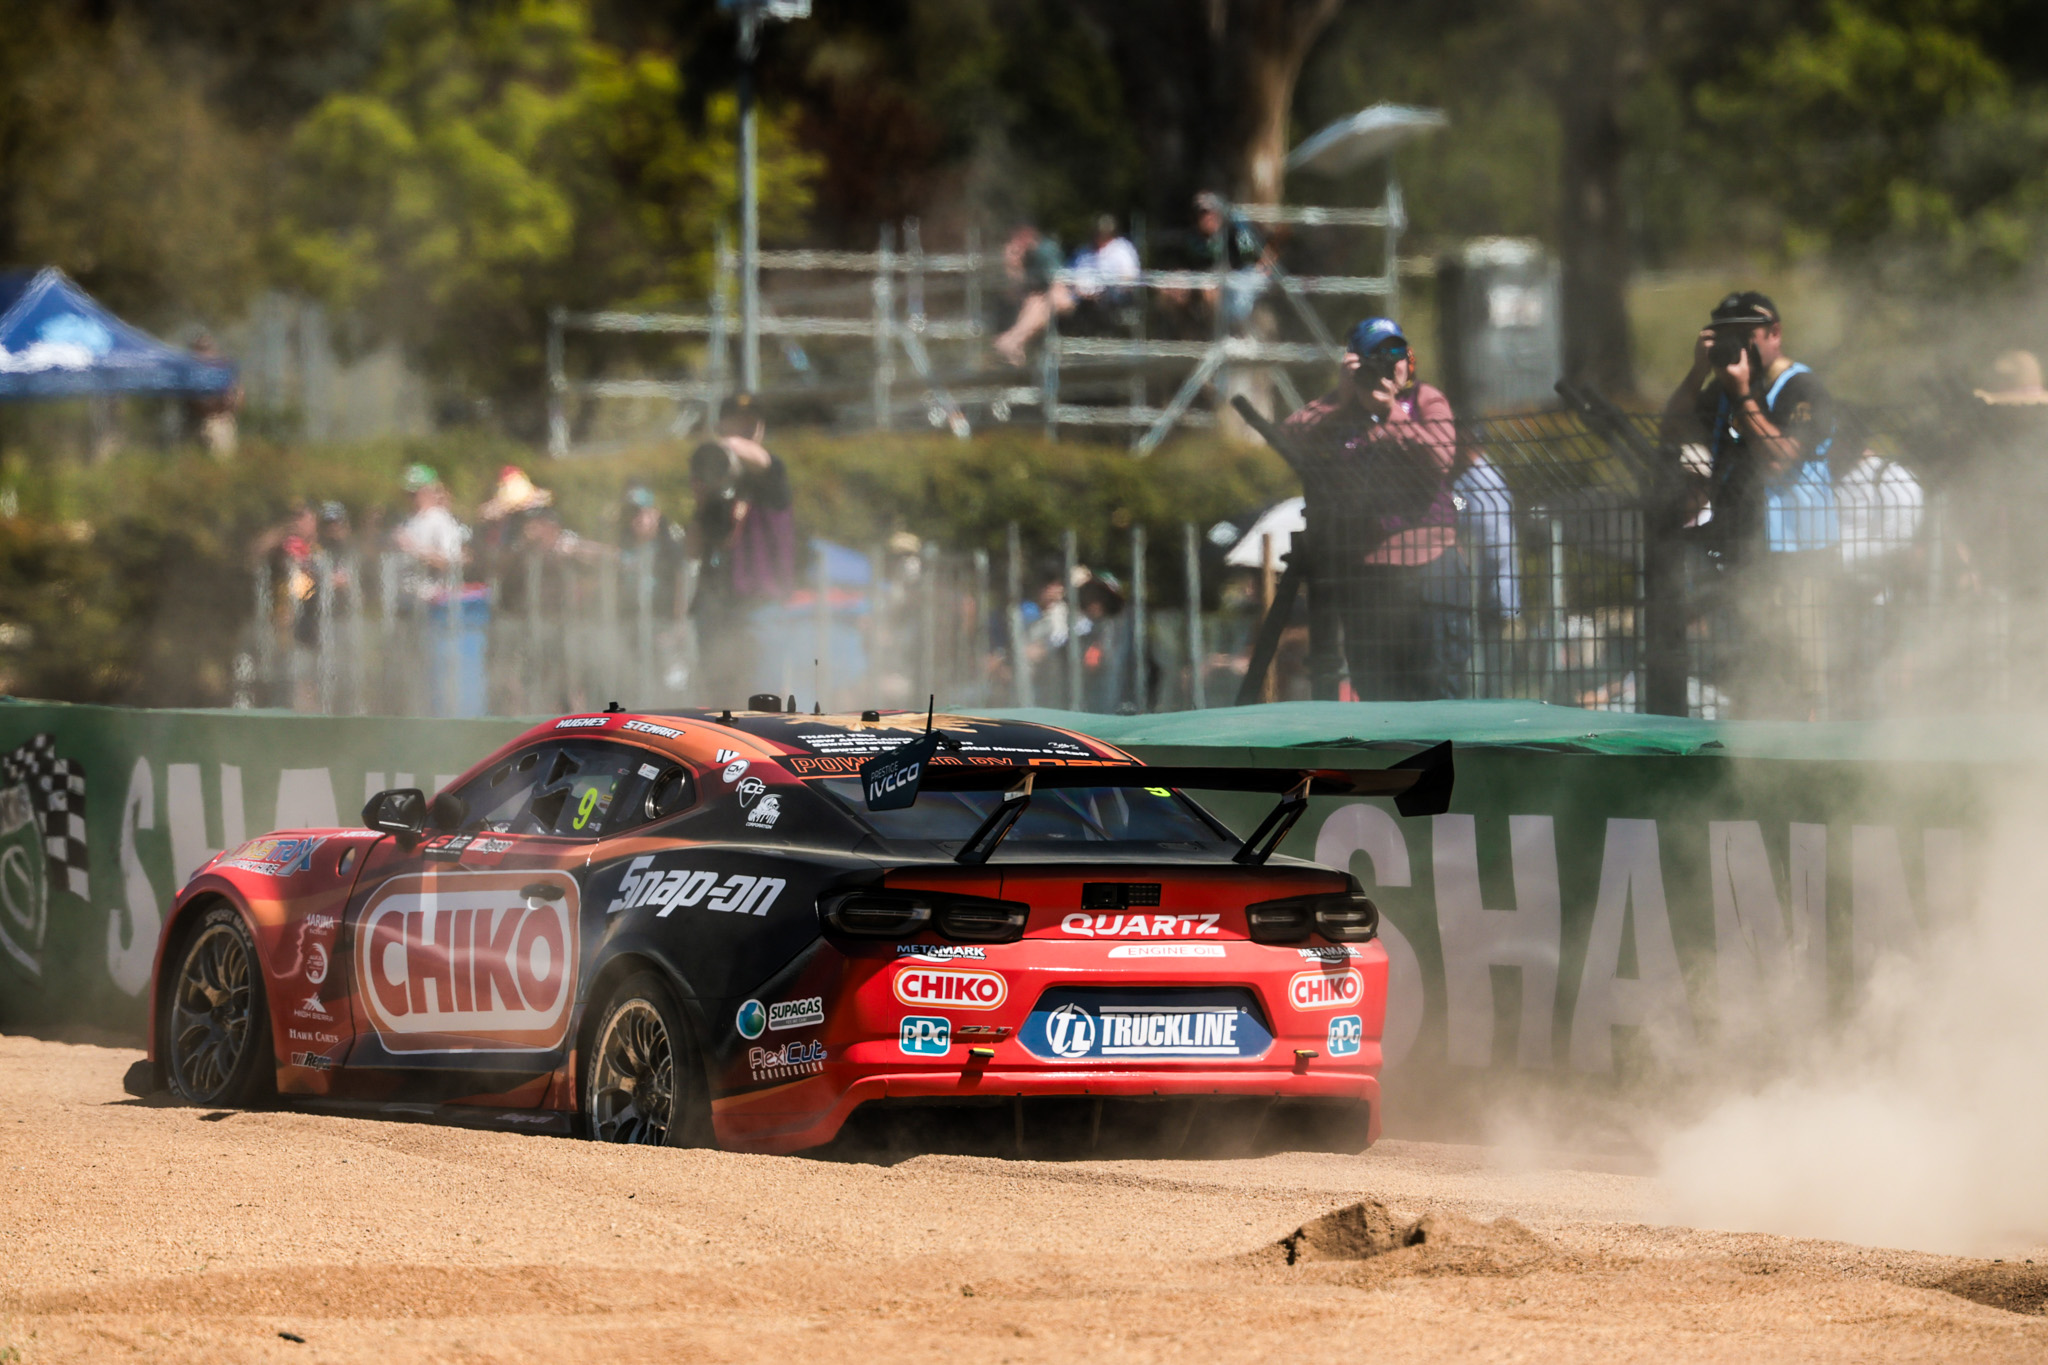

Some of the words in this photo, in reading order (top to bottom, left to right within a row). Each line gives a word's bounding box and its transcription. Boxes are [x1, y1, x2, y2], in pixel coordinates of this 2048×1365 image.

[555, 717, 612, 729] HUGHES
[622, 719, 686, 740] STEWART
[870, 762, 920, 801] IVECO
[871, 761, 899, 781] PRESTIGE
[573, 787, 598, 830] 9
[606, 855, 787, 918] Snap-on
[1060, 912, 1220, 938] QUARTZ
[369, 903, 565, 1018] CHIKO
[896, 945, 985, 957] METAMARK
[1128, 946, 1188, 956] ENGINE
[1193, 946, 1221, 956] OIL
[1296, 946, 1361, 957] METAMARK
[902, 973, 999, 1003] CHIKO
[1294, 976, 1358, 1004] CHIKO
[770, 999, 821, 1019] SUPAGAS
[902, 1020, 948, 1051] PPG
[1100, 1013, 1238, 1046] TRUCKLINE
[1329, 1020, 1360, 1052] PPG
